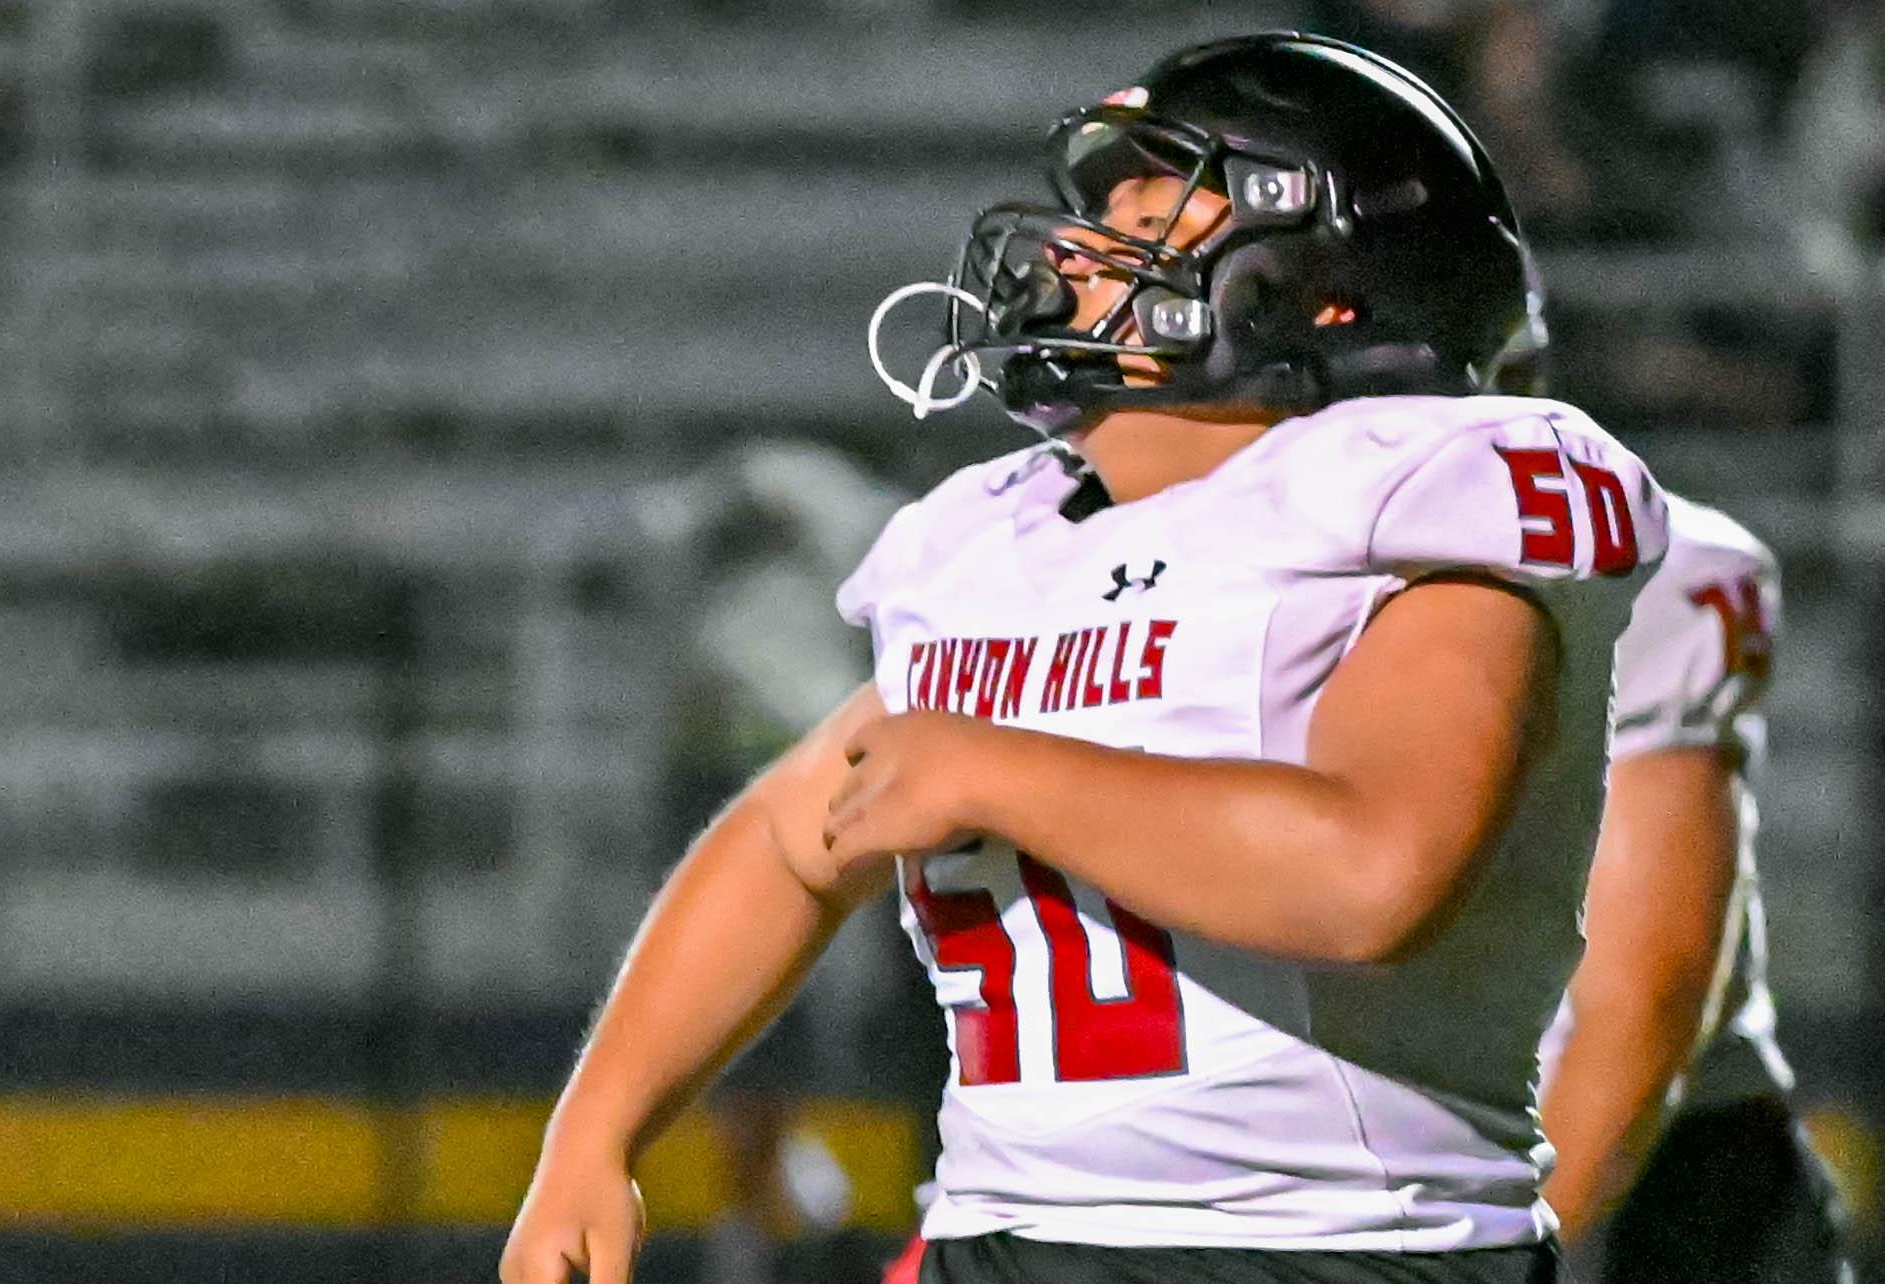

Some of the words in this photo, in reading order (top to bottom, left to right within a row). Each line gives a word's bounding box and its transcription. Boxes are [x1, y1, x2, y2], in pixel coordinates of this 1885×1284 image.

[1490, 444, 1639, 578] 50
[906, 636, 1039, 720] CANYON
[1039, 618, 1179, 714] HILLS
